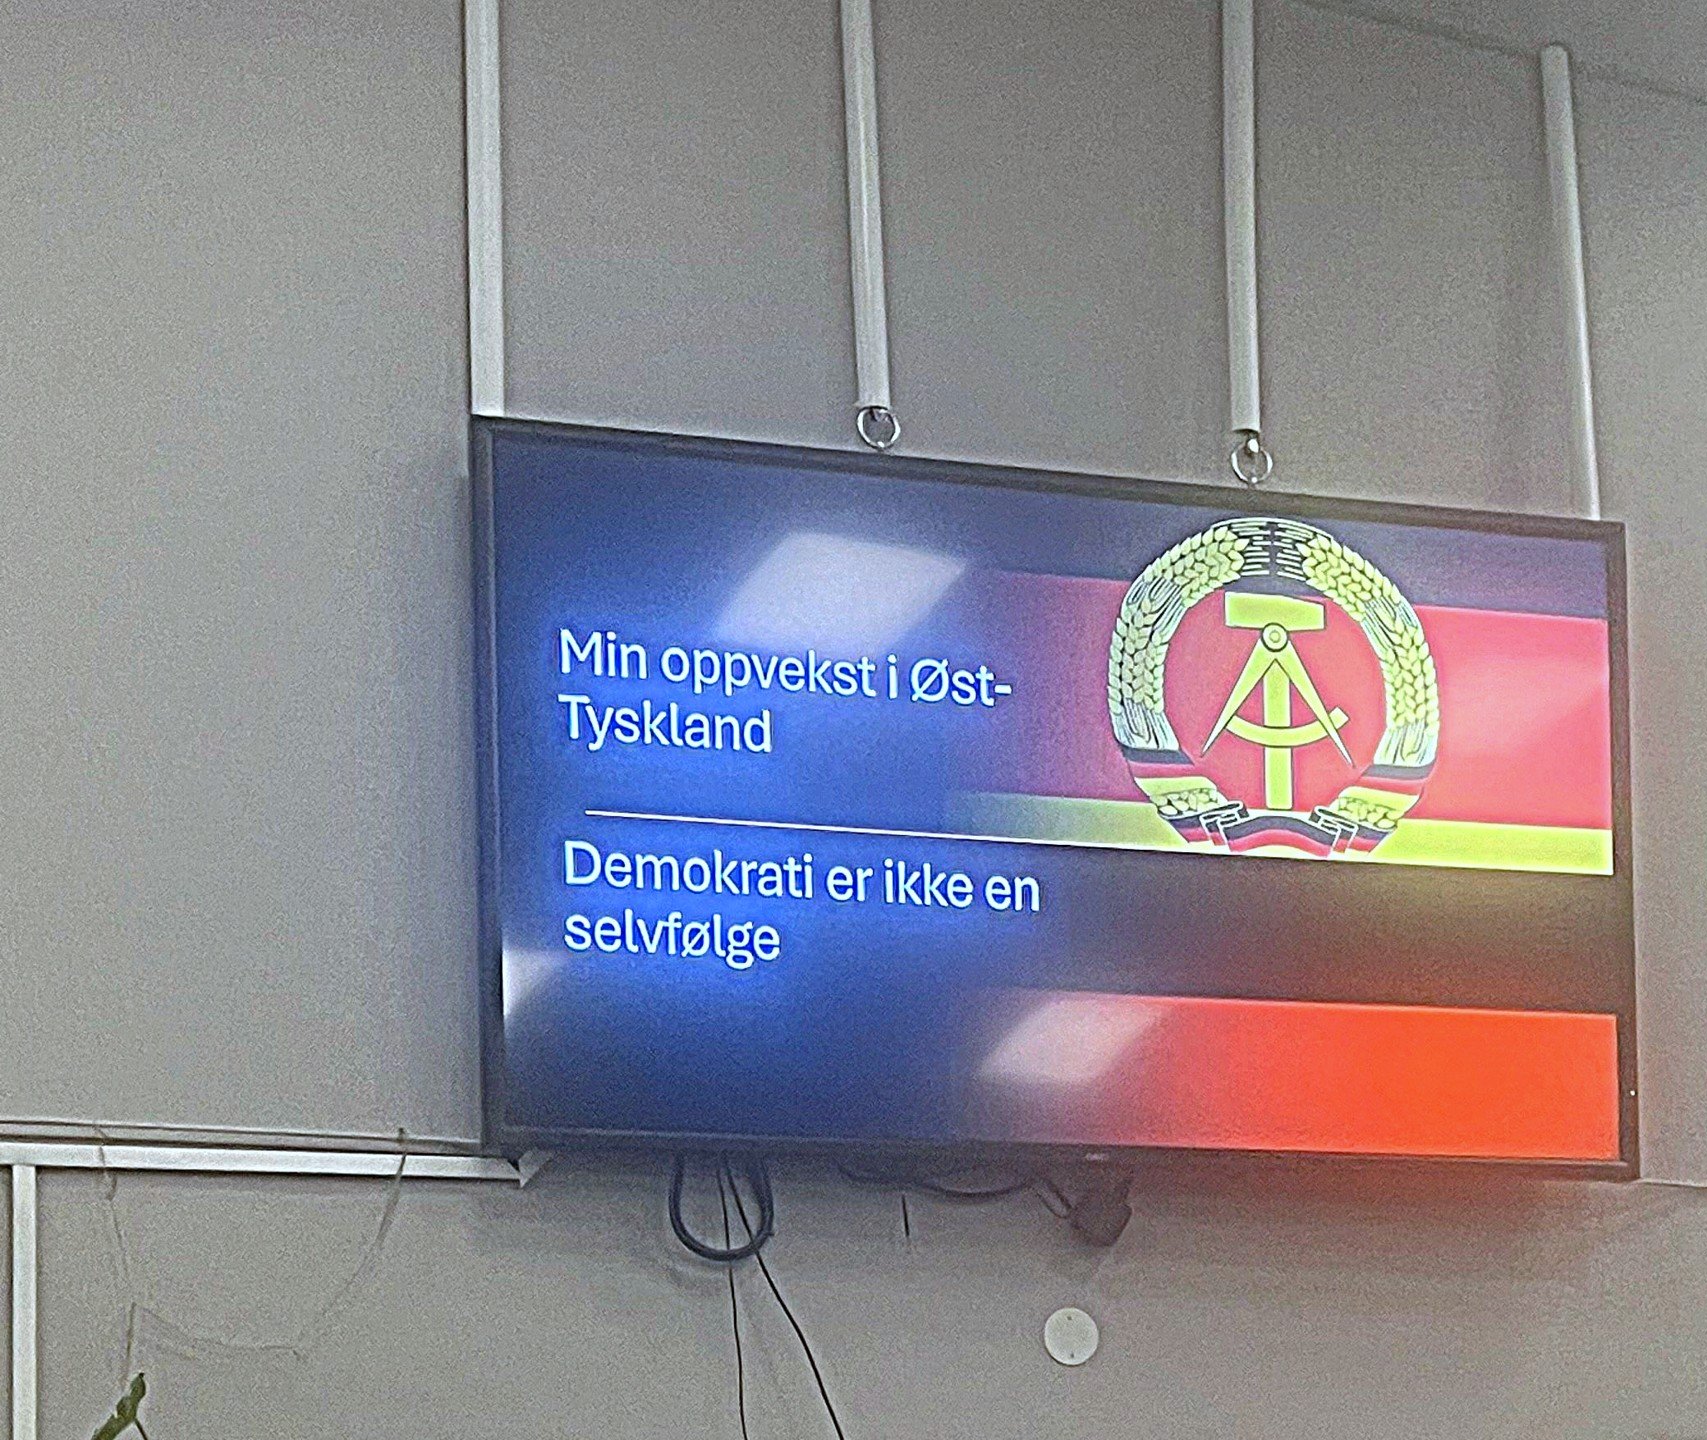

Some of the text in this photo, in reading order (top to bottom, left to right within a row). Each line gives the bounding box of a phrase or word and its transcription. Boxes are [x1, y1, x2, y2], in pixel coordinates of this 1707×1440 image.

[559, 628, 1013, 707] Min oppvekst i Øst-
[557, 693, 773, 753] Tyskland
[564, 840, 1041, 911] Demokrati er ikke en
[564, 908, 781, 970] selvfølge
